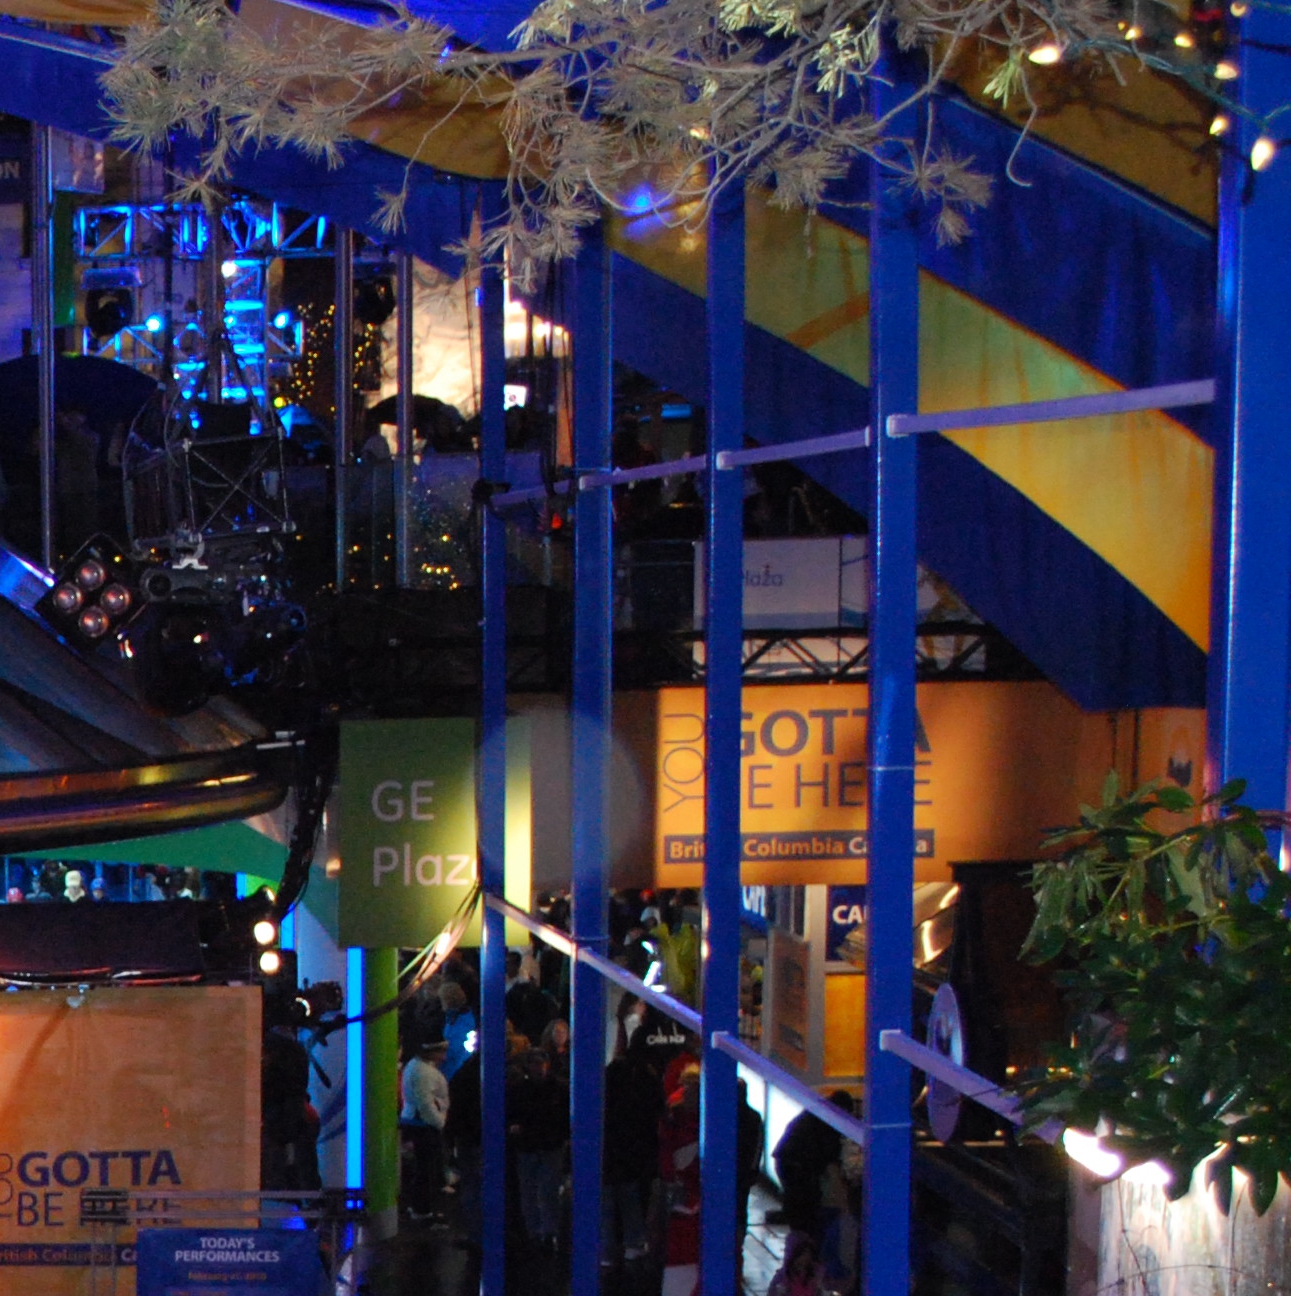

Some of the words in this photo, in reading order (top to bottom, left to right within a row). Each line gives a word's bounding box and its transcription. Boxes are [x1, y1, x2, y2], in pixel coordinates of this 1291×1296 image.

[663, 712, 706, 813] YOU
[370, 779, 435, 822] GE
[747, 763, 774, 810] E
[794, 759, 932, 809] HEE
[372, 841, 478, 888] Plaz
[670, 838, 706, 859] Brit
[743, 837, 845, 857] Columbia
[17, 1149, 182, 1189] GOTTA
[17, 1192, 64, 1228] BE
[174, 1250, 280, 1263] PERFORMANCES
[200, 1237, 256, 1250] TODAY'S
